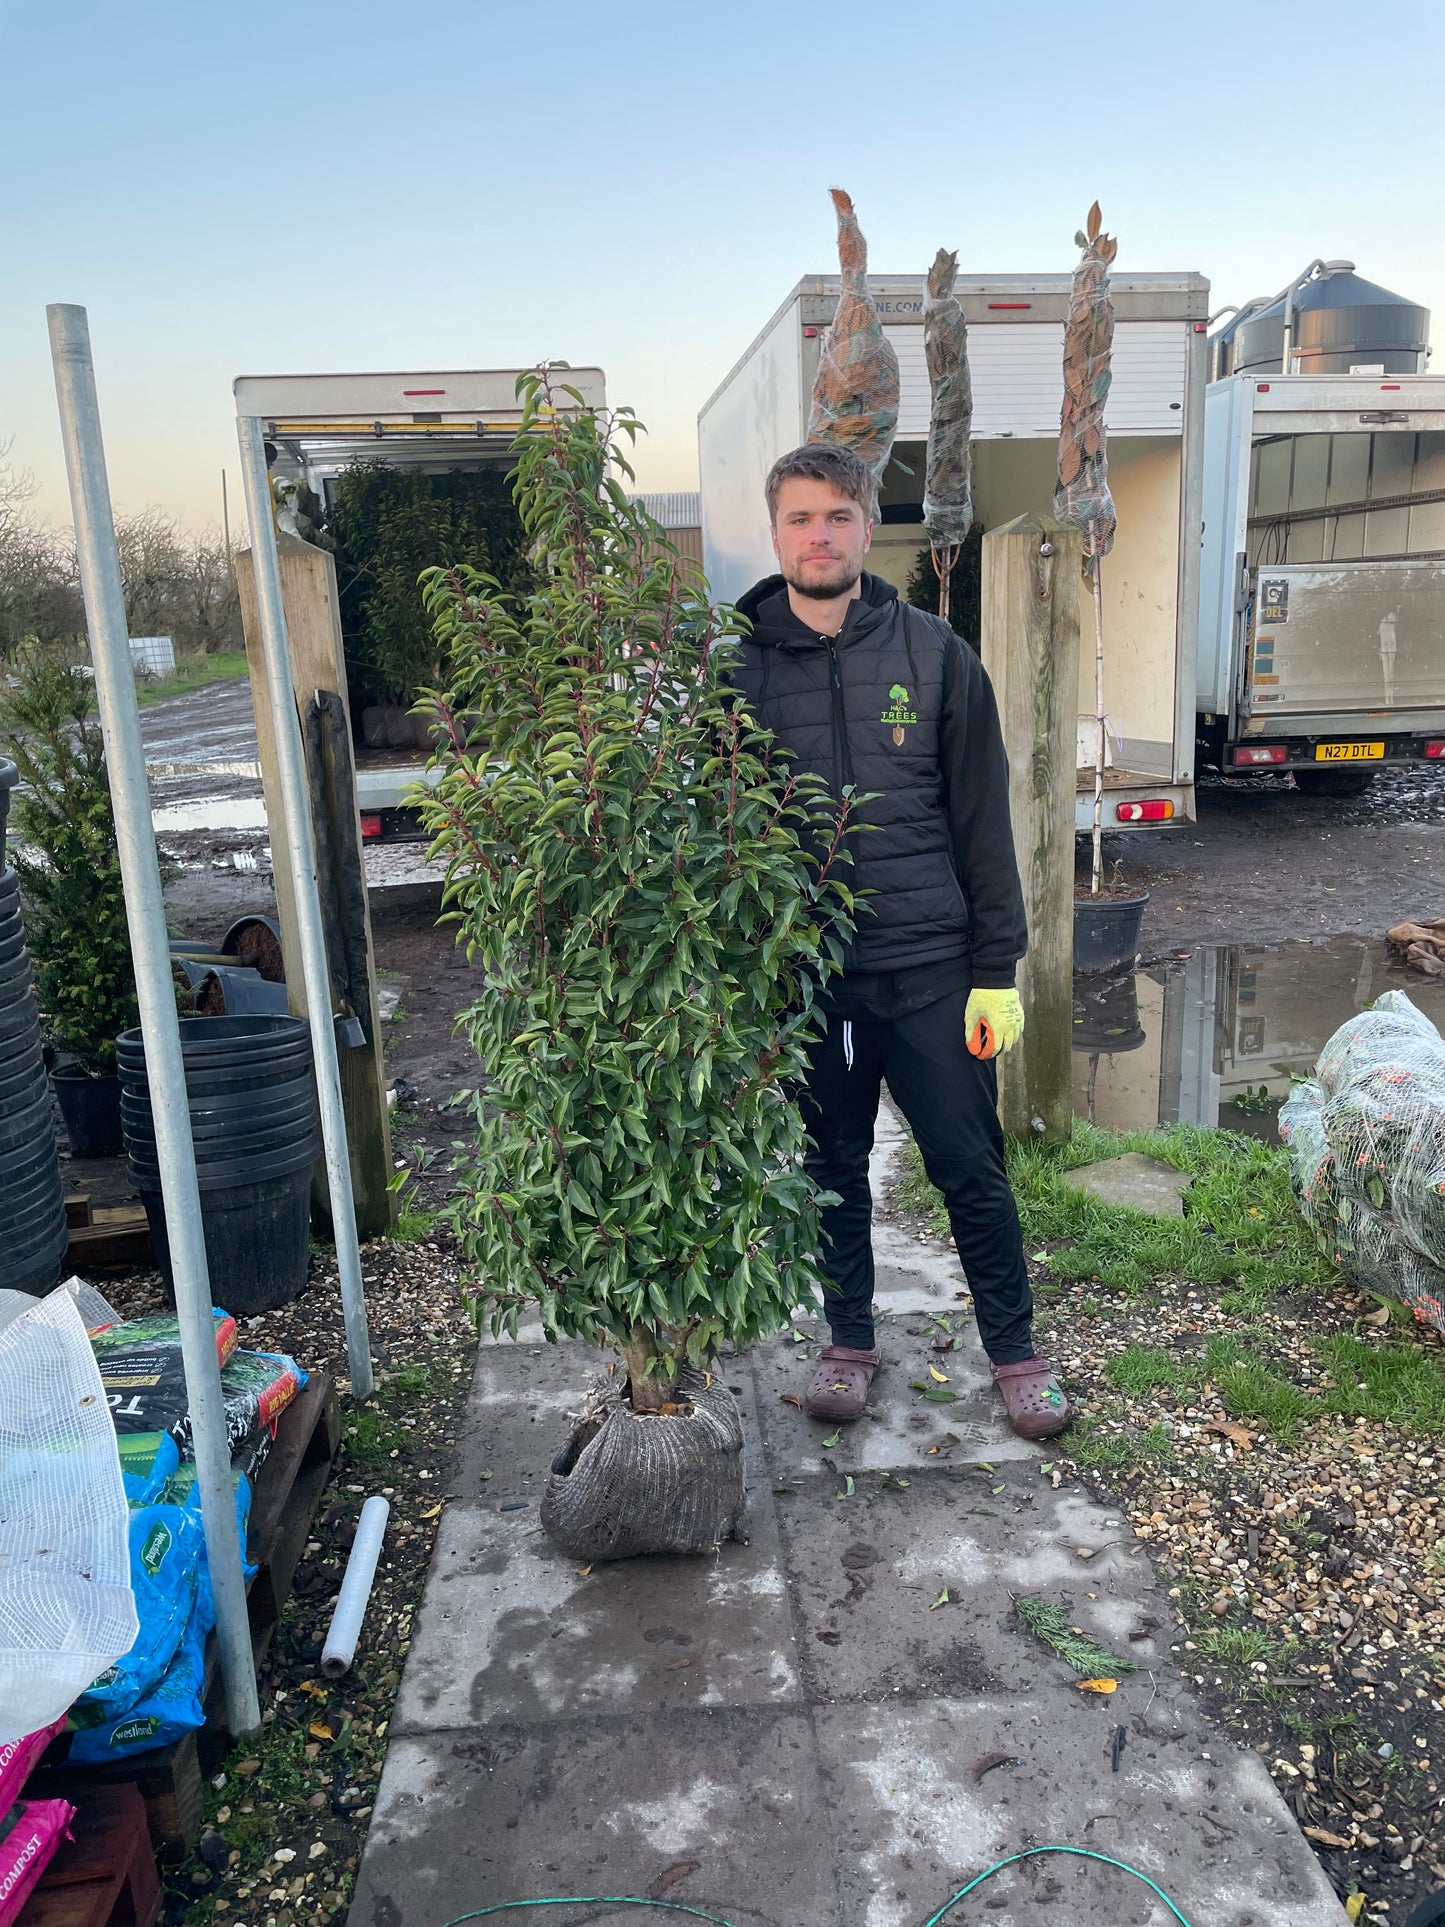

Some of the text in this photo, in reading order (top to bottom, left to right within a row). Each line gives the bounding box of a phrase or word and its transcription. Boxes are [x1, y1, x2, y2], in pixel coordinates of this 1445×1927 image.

[1265, 605, 1283, 618] DEL
[881, 711, 917, 720] TREES
[1325, 744, 1375, 758] N27 DTL
[116, 1723, 152, 1740] westland
